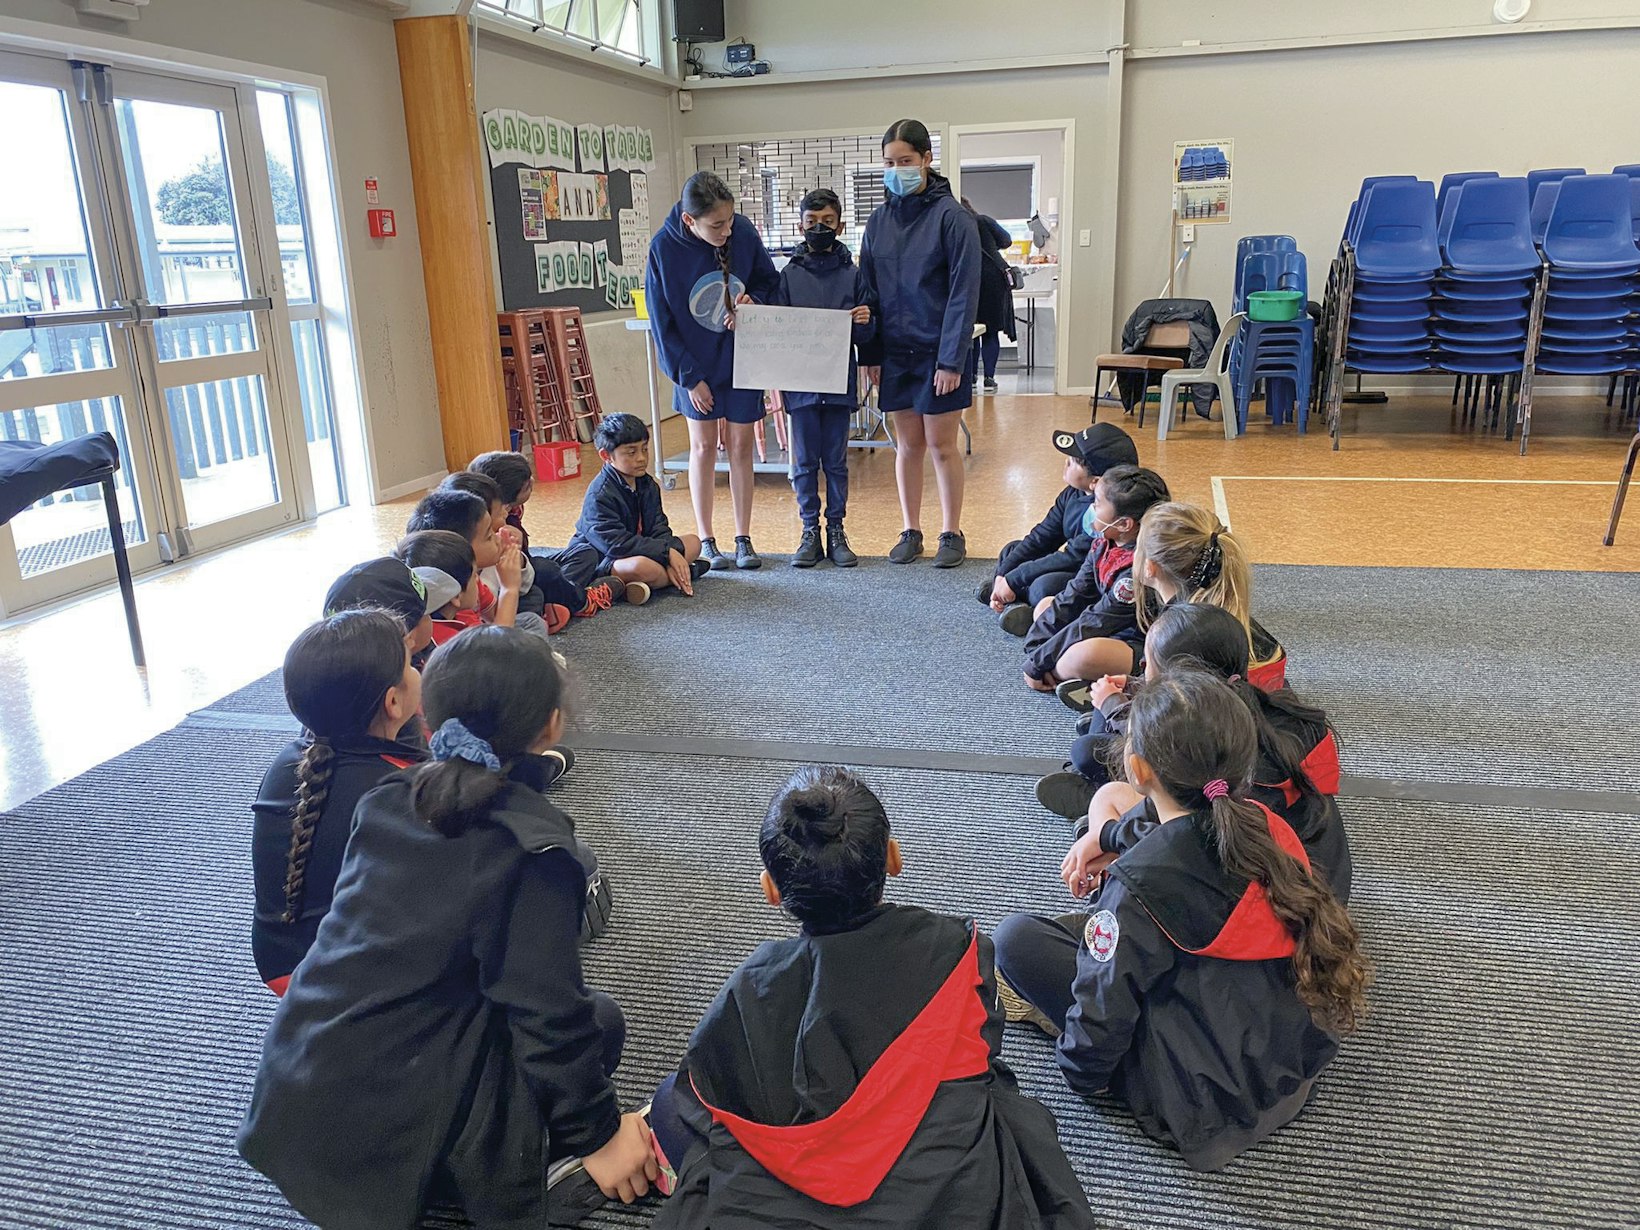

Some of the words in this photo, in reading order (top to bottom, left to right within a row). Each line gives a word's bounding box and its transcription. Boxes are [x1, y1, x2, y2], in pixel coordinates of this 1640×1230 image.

[488, 117, 573, 159] GARDEN
[580, 131, 602, 160] TO
[606, 132, 653, 162] TABLE
[564, 189, 594, 216] AND
[539, 254, 591, 289] FOOD
[598, 252, 639, 304] TECH
